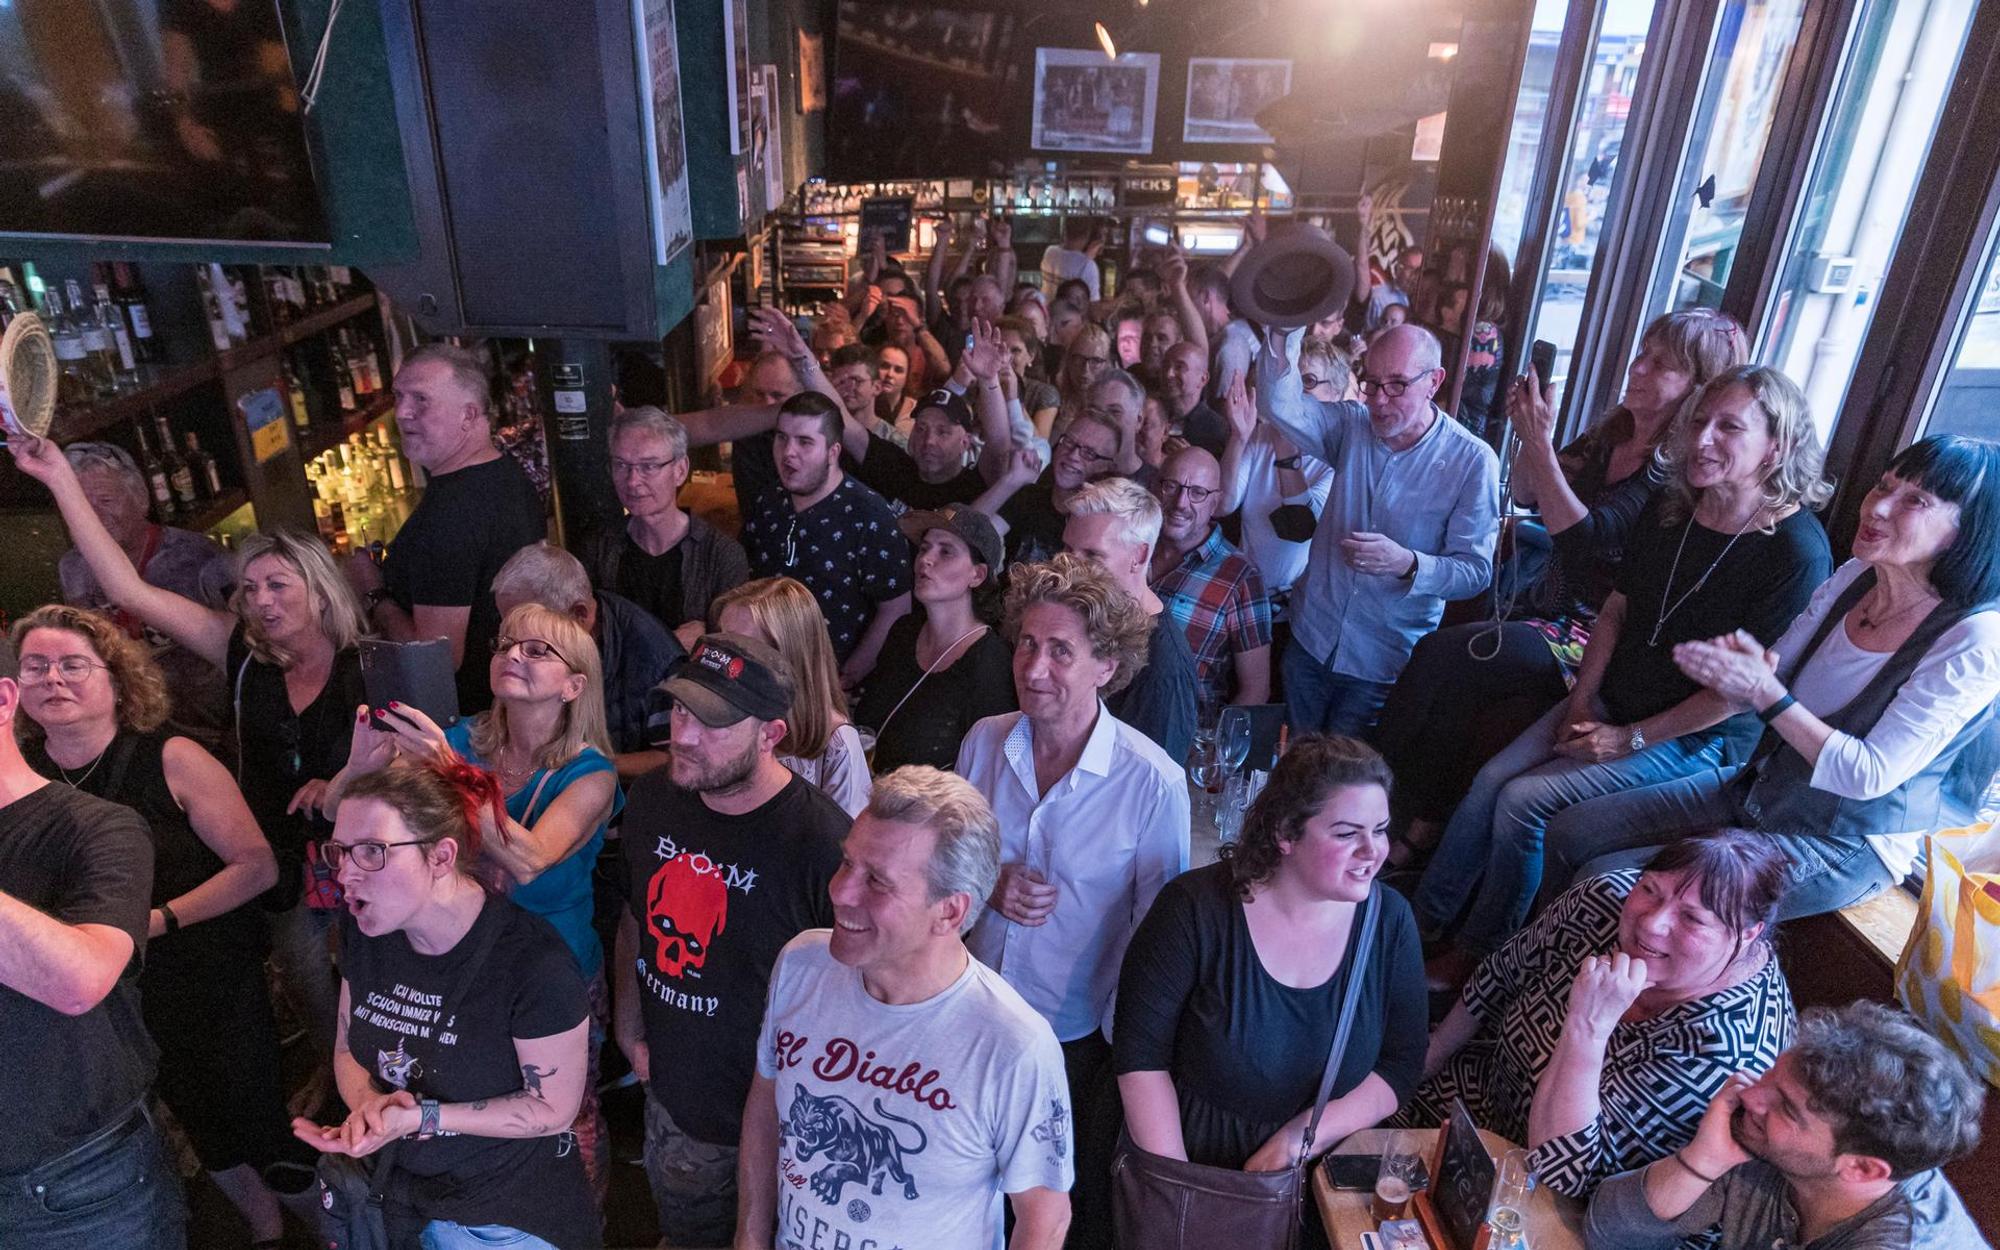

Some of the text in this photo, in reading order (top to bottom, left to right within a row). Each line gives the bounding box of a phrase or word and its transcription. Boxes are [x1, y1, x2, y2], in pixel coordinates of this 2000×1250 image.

[366, 992, 456, 1028] SCHON IMMER WS
[392, 984, 443, 1007] ICH WOLLTE
[353, 1005, 458, 1045] MIT MENSCHEN MHEN
[813, 1037, 956, 1110] Diablo
